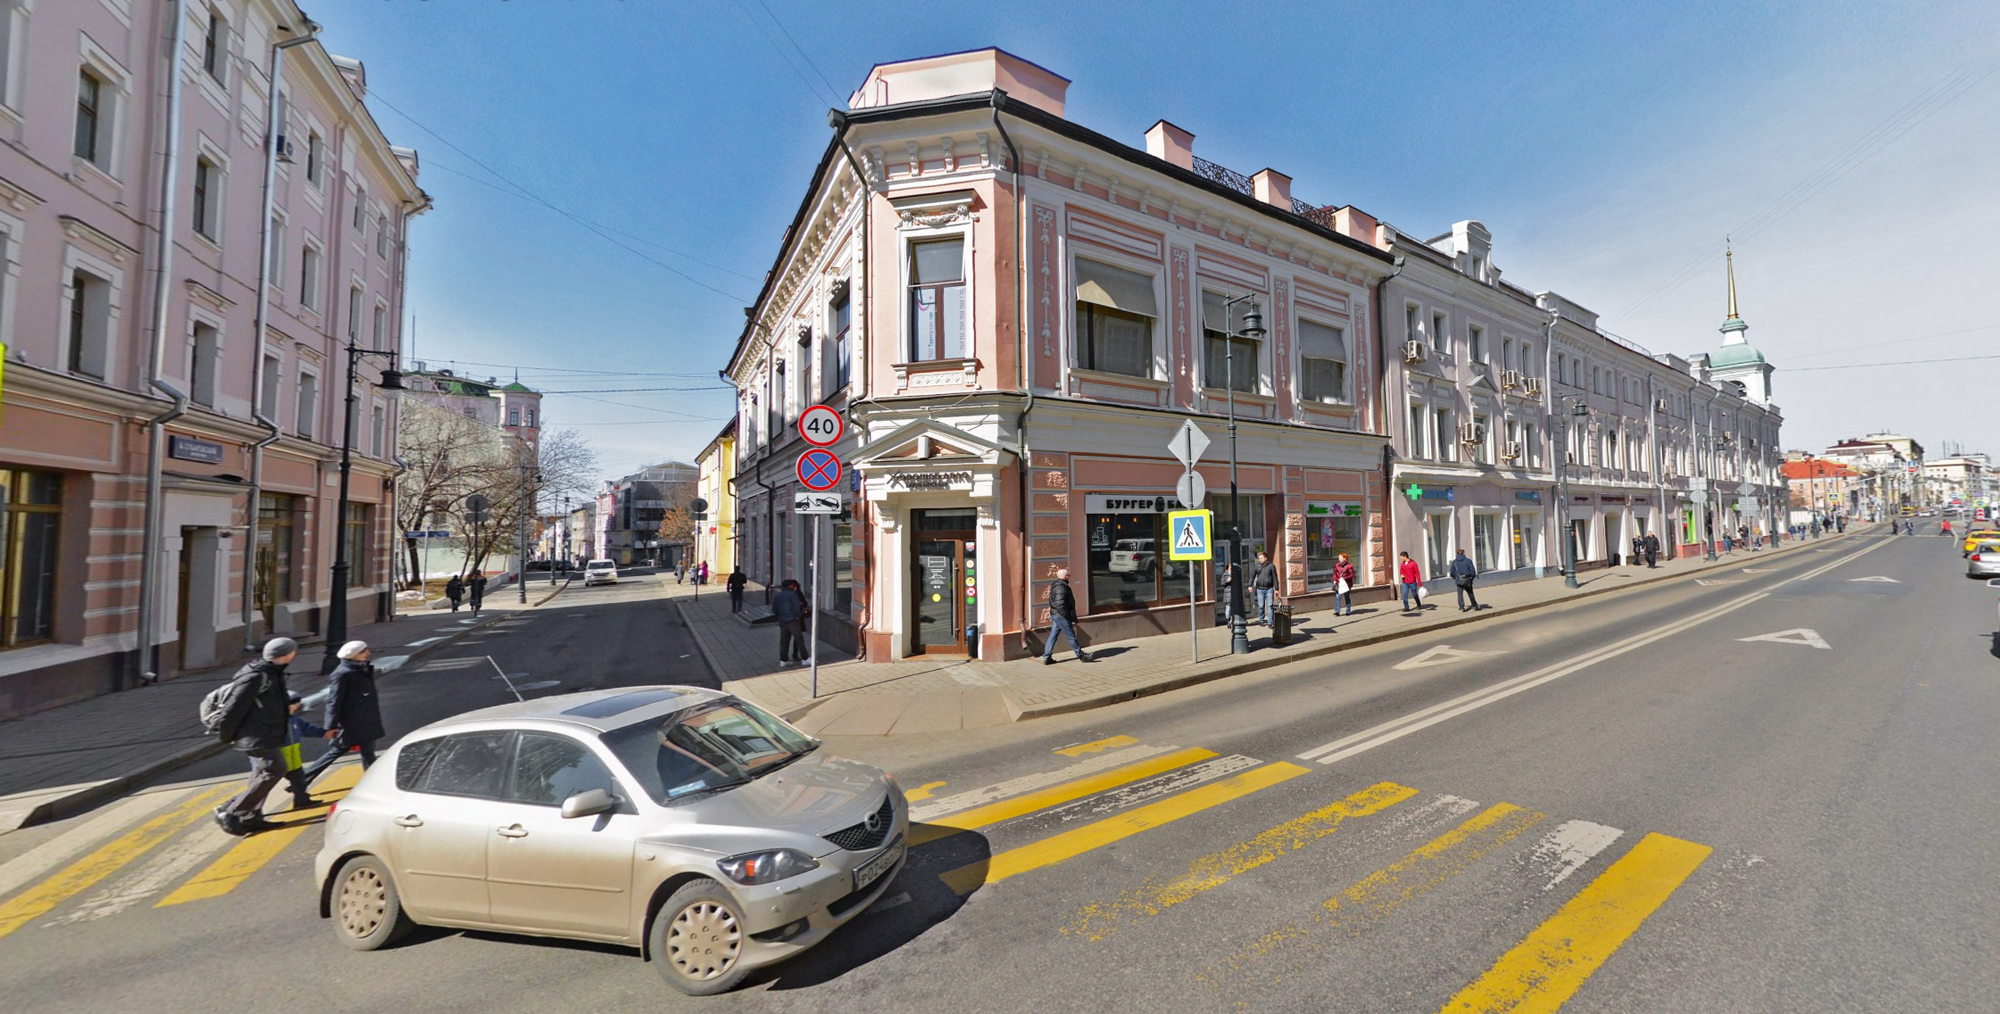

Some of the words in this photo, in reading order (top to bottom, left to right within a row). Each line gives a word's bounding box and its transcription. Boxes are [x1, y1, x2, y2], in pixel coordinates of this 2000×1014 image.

[807, 418, 834, 434] 40
[1106, 499, 1154, 510] БУРГЕР
[1167, 499, 1188, 510] БА
